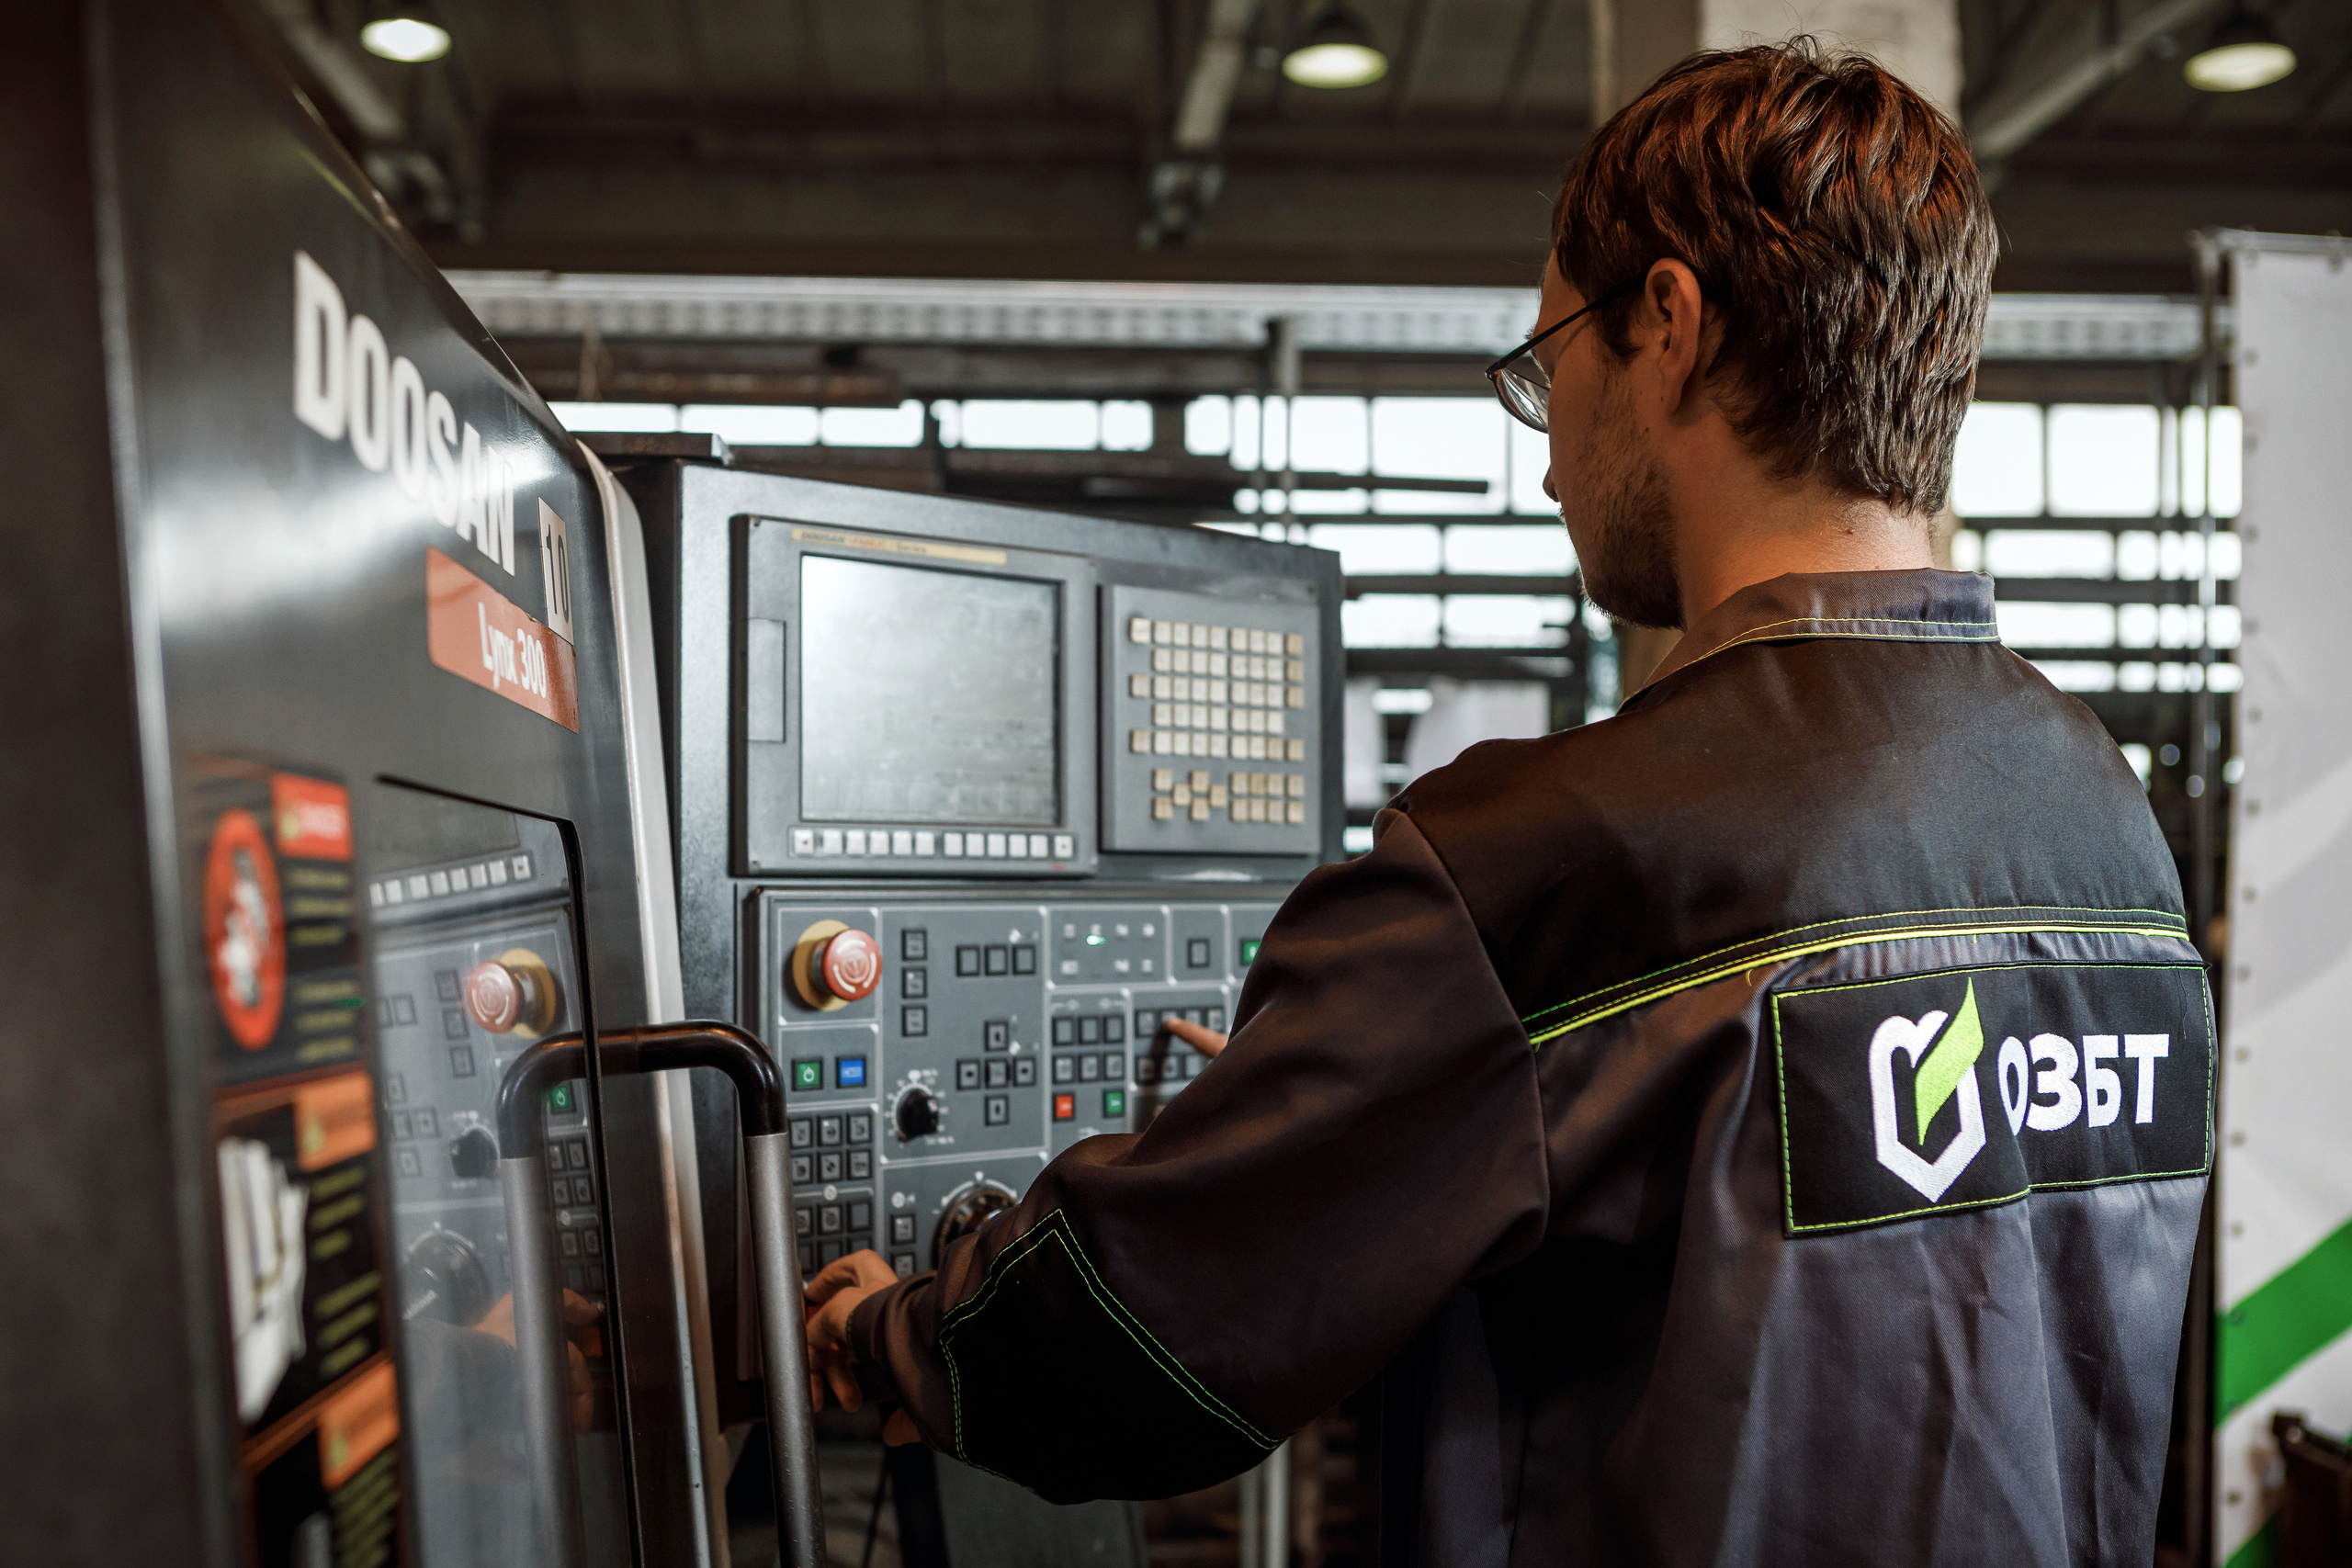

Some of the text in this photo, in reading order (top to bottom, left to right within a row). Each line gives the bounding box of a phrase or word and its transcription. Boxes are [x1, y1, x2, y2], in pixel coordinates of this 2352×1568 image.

[293, 249, 515, 577] DOOSAN
[546, 513, 570, 624] 10
[516, 627, 547, 698] 300
